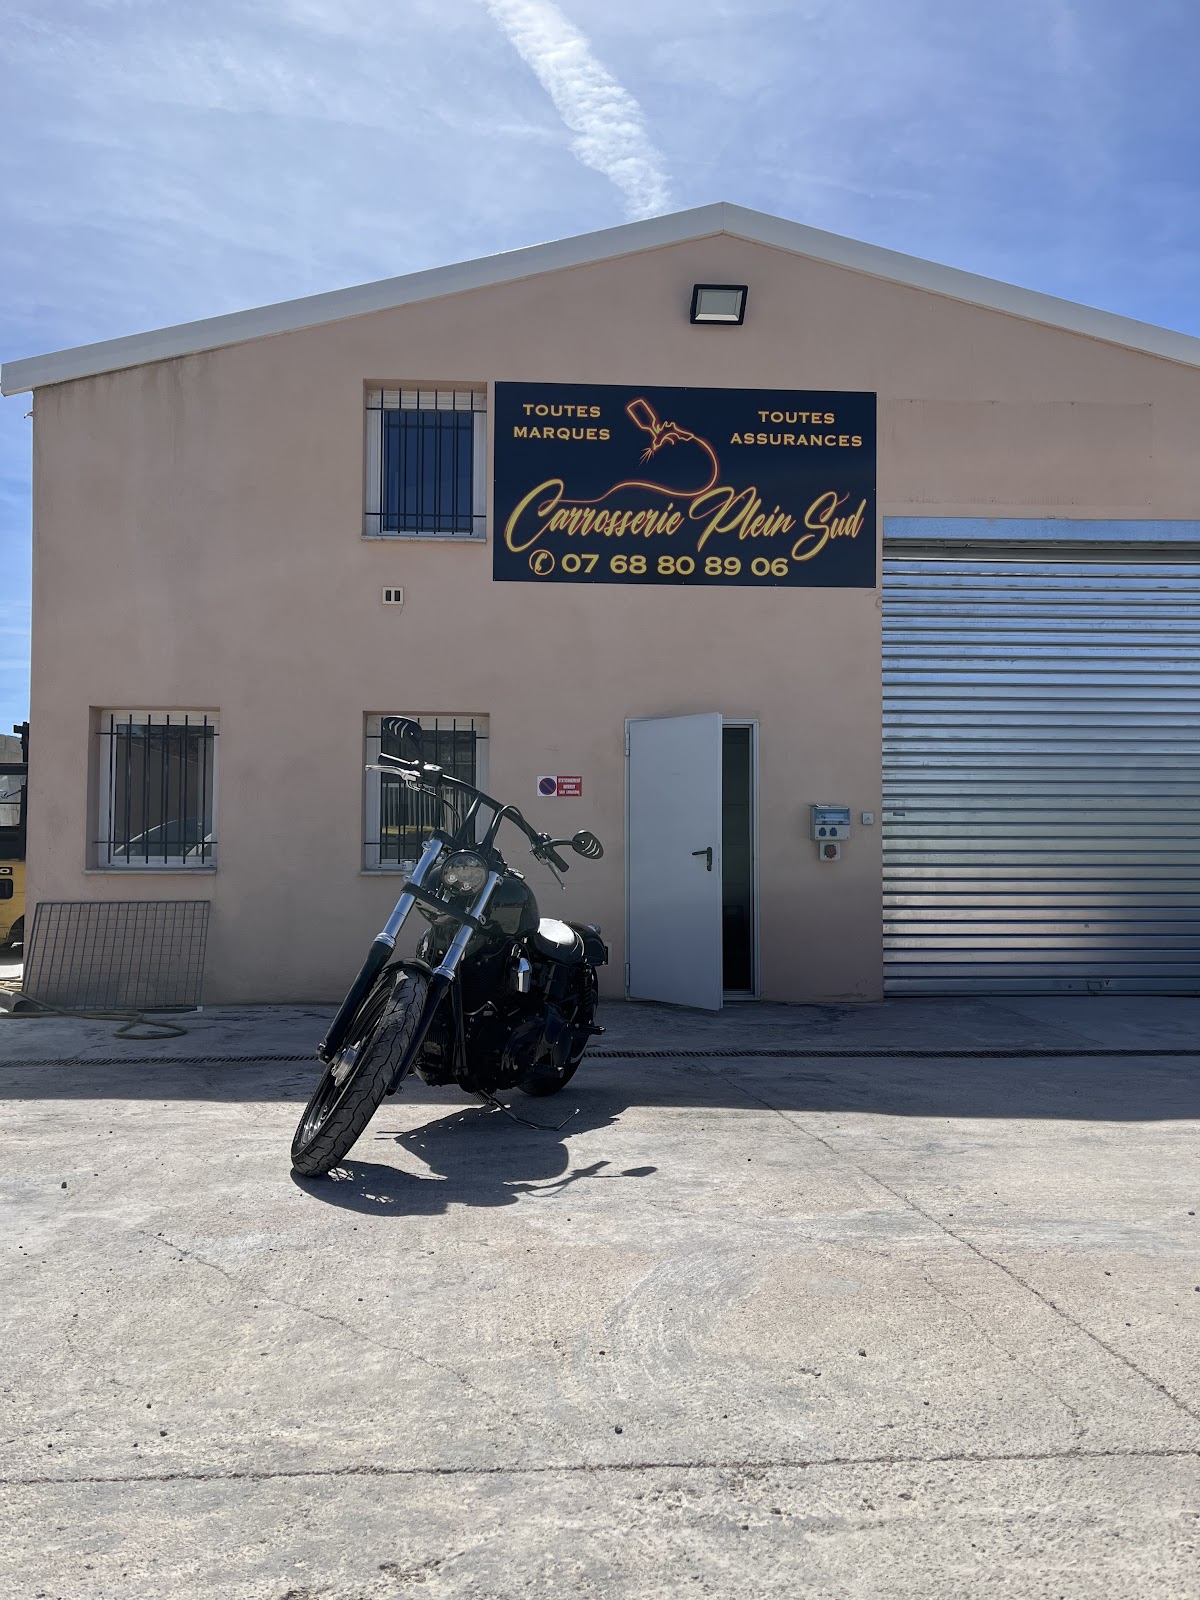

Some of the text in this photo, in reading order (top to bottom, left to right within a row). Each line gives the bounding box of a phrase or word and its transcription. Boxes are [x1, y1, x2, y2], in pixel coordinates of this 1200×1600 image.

[522, 403, 602, 418] TOUTES
[758, 410, 836, 424] TOUTES
[513, 426, 611, 441] MARQUES
[730, 432, 863, 447] ASSURANCES
[504, 478, 867, 560] Carrosserie Plein Sud
[561, 553, 789, 577] 07 68 80 89 06
